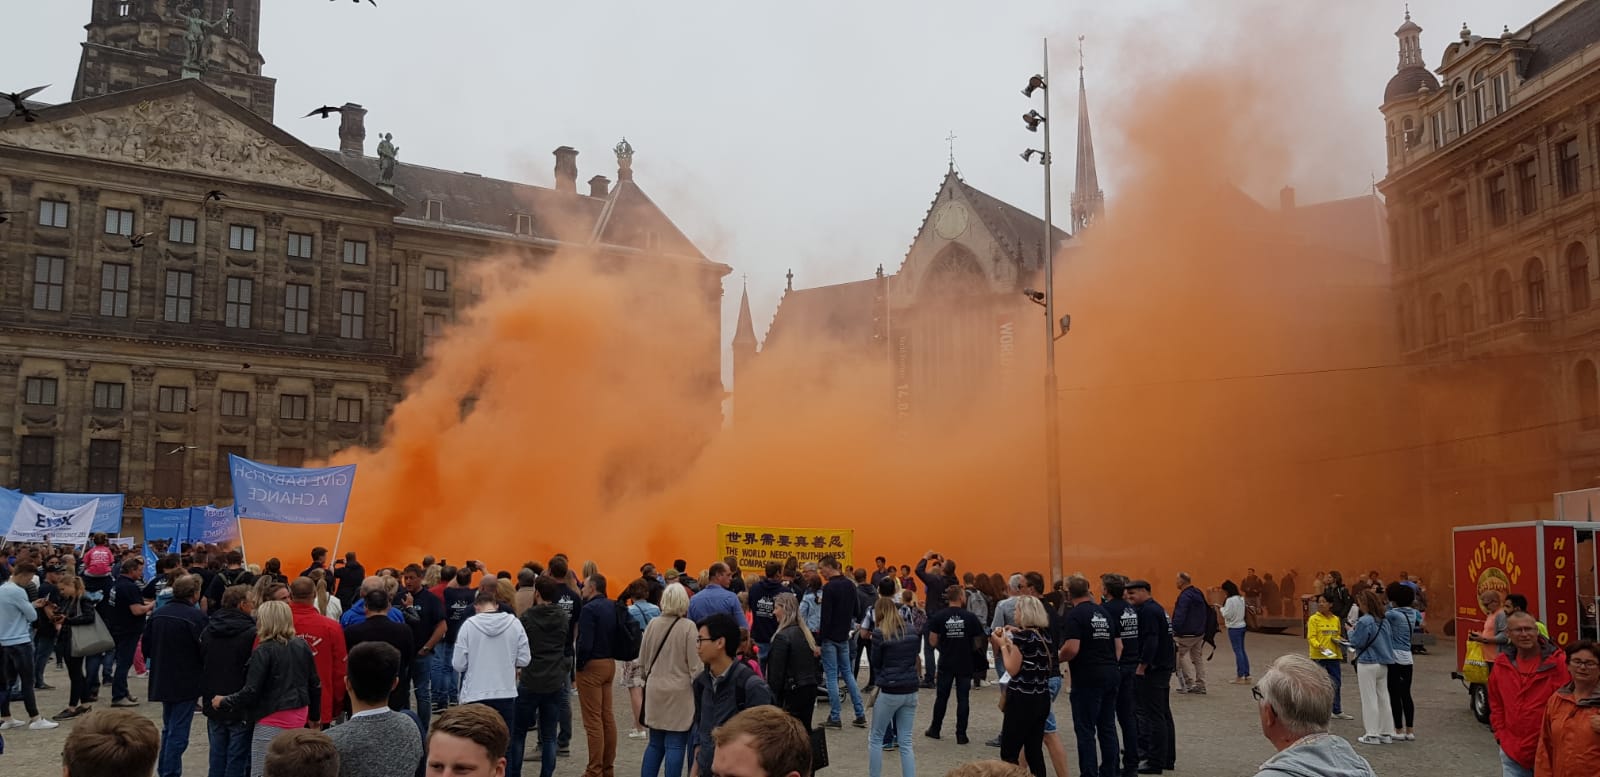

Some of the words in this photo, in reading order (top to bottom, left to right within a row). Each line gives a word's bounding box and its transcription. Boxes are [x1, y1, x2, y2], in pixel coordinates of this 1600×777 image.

[726, 546, 738, 556] THE
[742, 548, 766, 557] WORLD
[770, 550, 792, 560] NEEDS
[1468, 536, 1521, 585] HOT-DOGS
